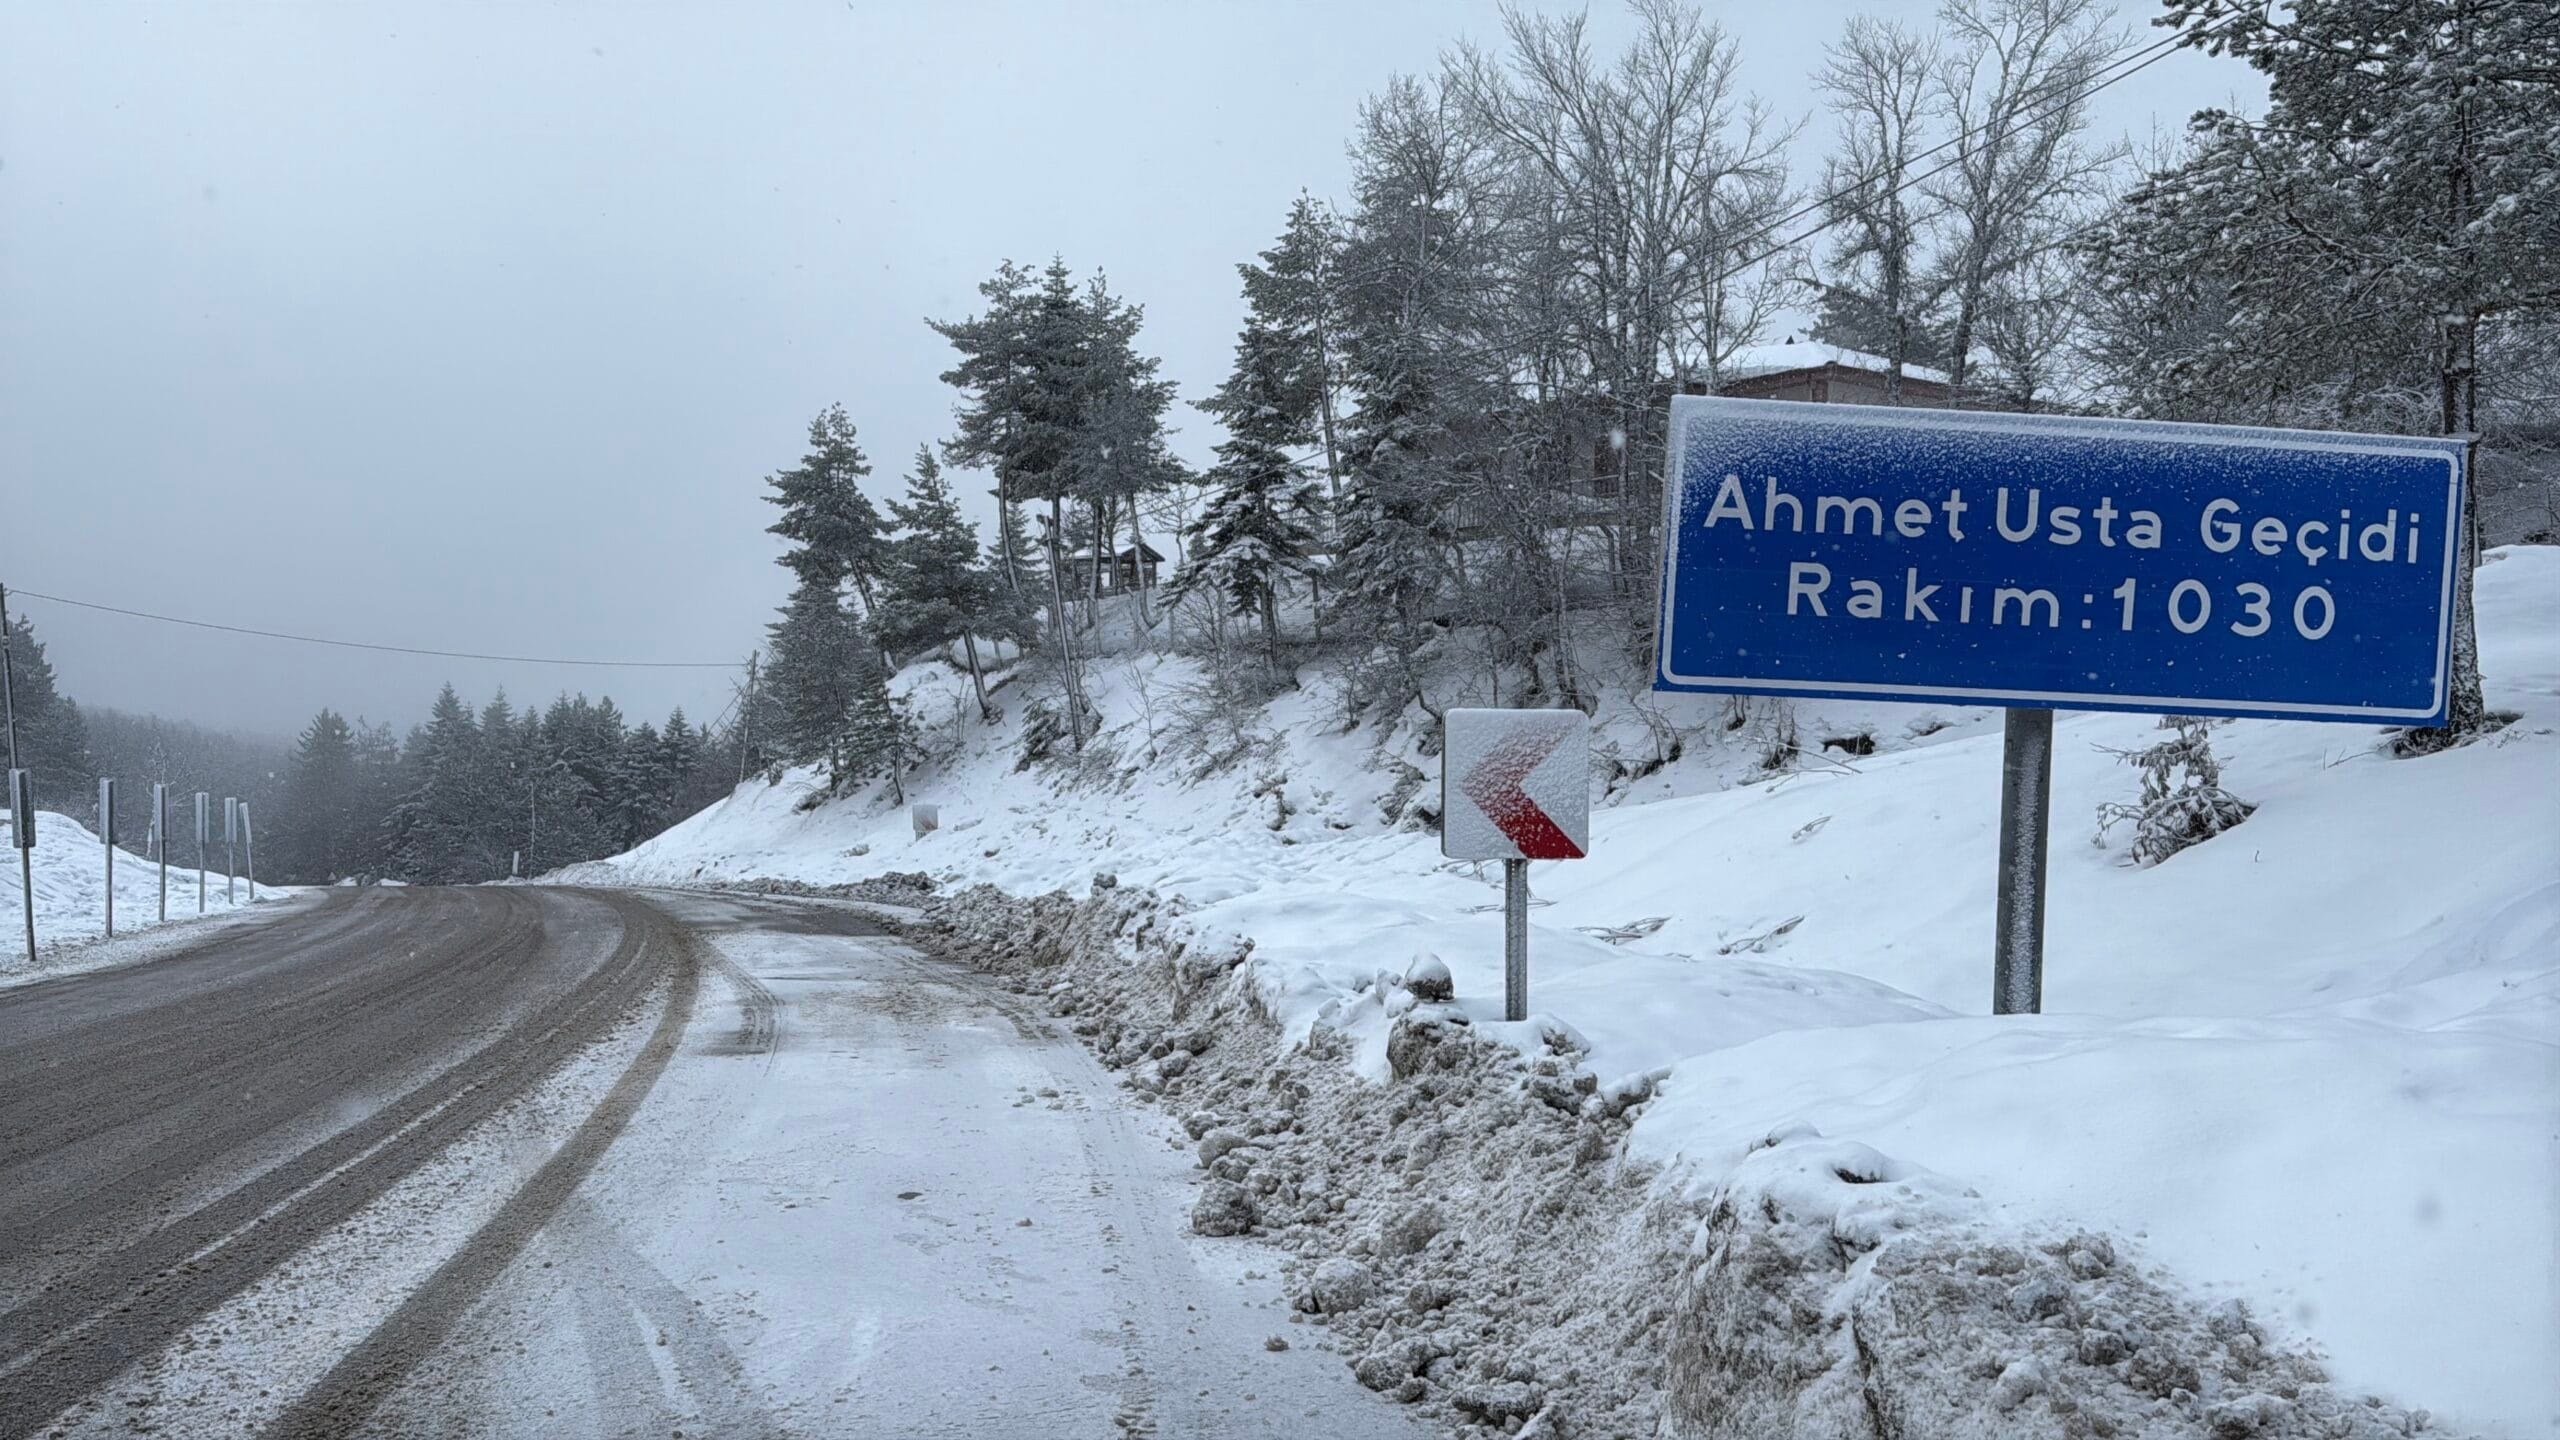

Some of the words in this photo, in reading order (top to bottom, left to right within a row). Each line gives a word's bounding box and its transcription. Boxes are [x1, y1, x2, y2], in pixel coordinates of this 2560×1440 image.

[1704, 473, 1967, 543] Ahmet
[1996, 488, 2162, 549] Usta
[2200, 498, 2420, 567] Geçidi
